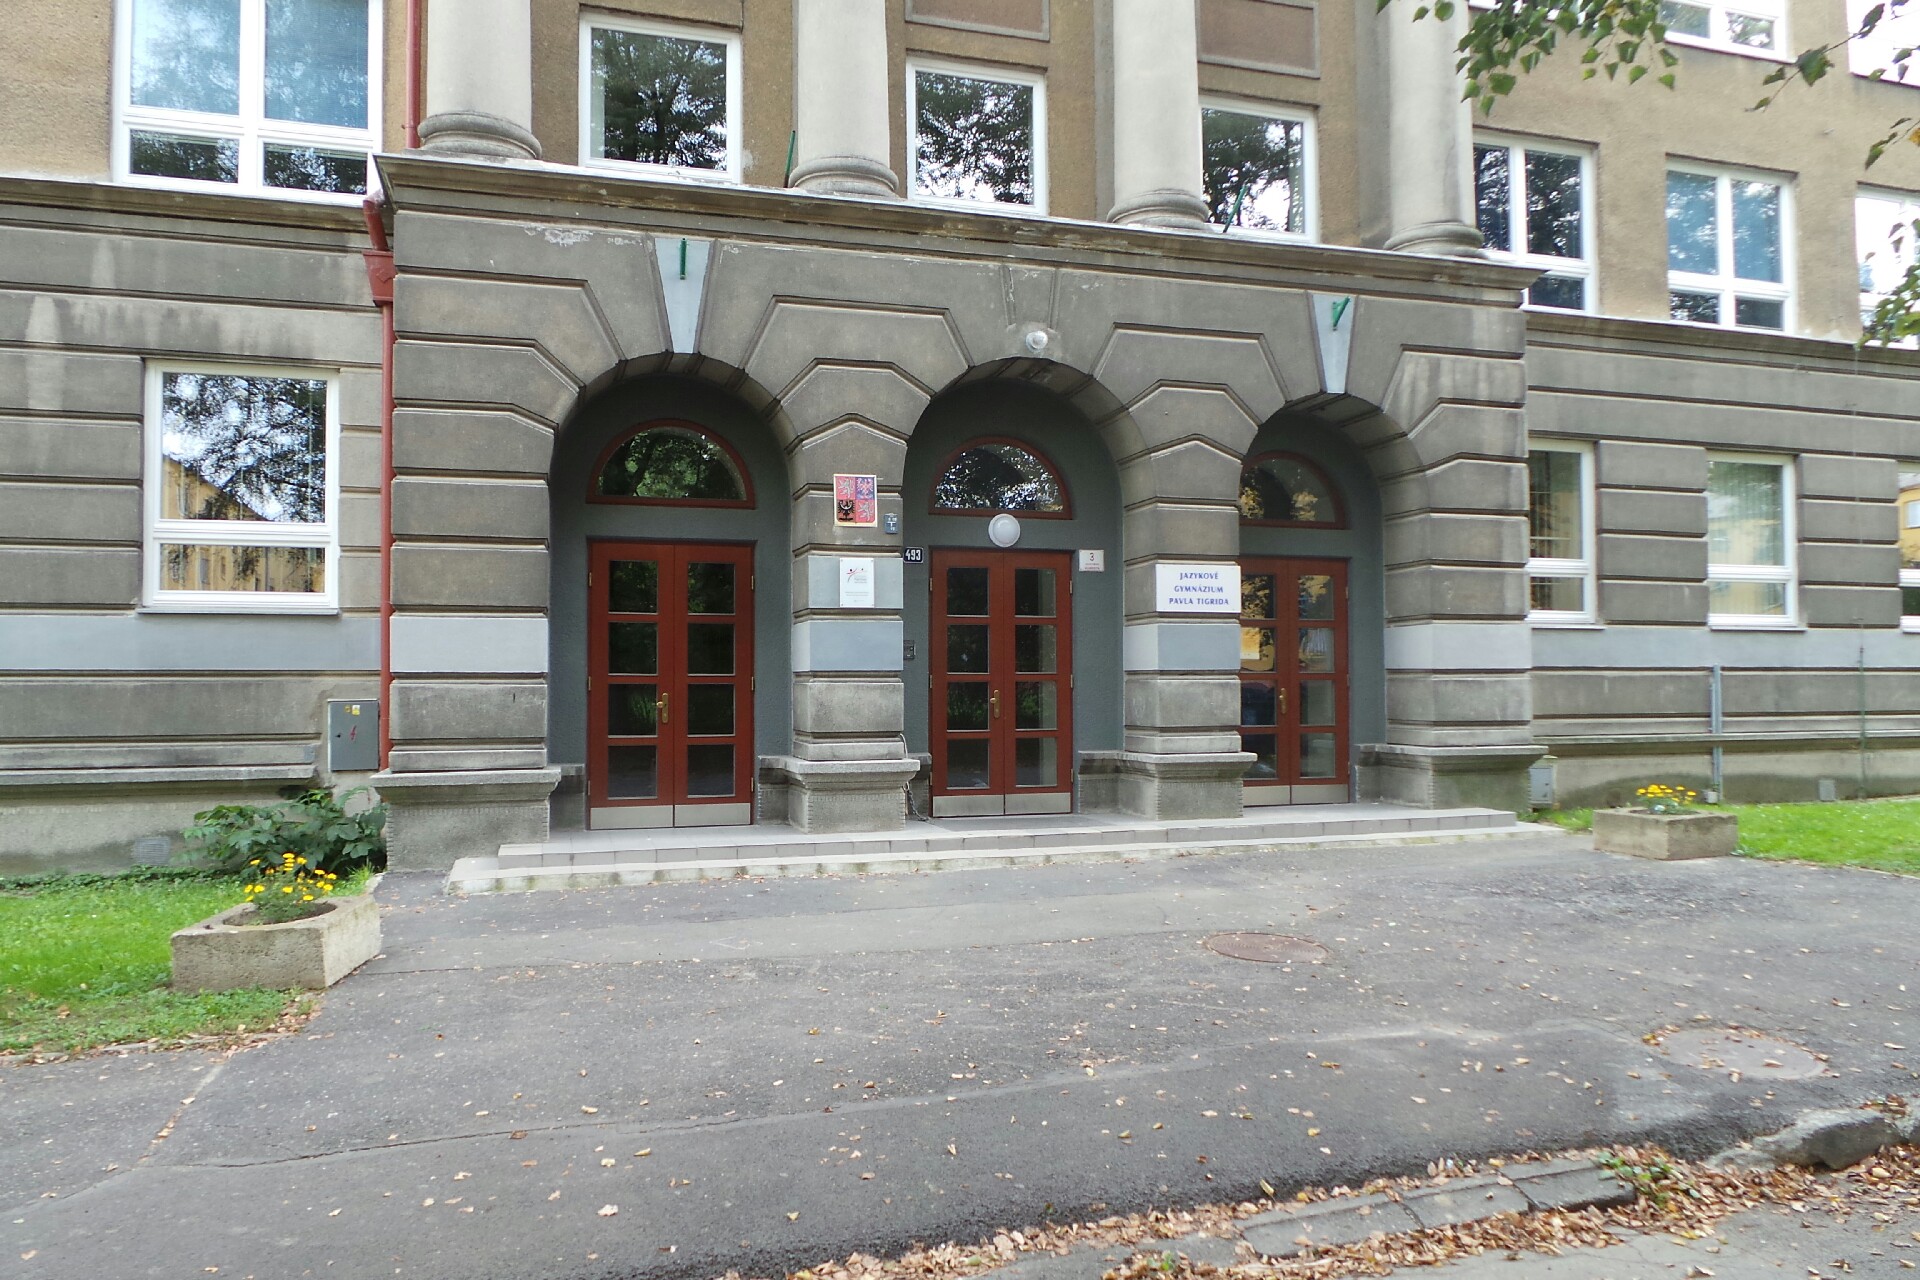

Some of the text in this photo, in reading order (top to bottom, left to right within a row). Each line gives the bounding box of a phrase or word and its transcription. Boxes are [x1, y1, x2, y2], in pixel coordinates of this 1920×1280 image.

[905, 549, 921, 561] 493
[1089, 552, 1095, 562] 3
[1179, 571, 1219, 580] JAZYKOVÉ
[1173, 584, 1224, 593] GYMNÁZIUM
[1169, 597, 1194, 605] PAVLA
